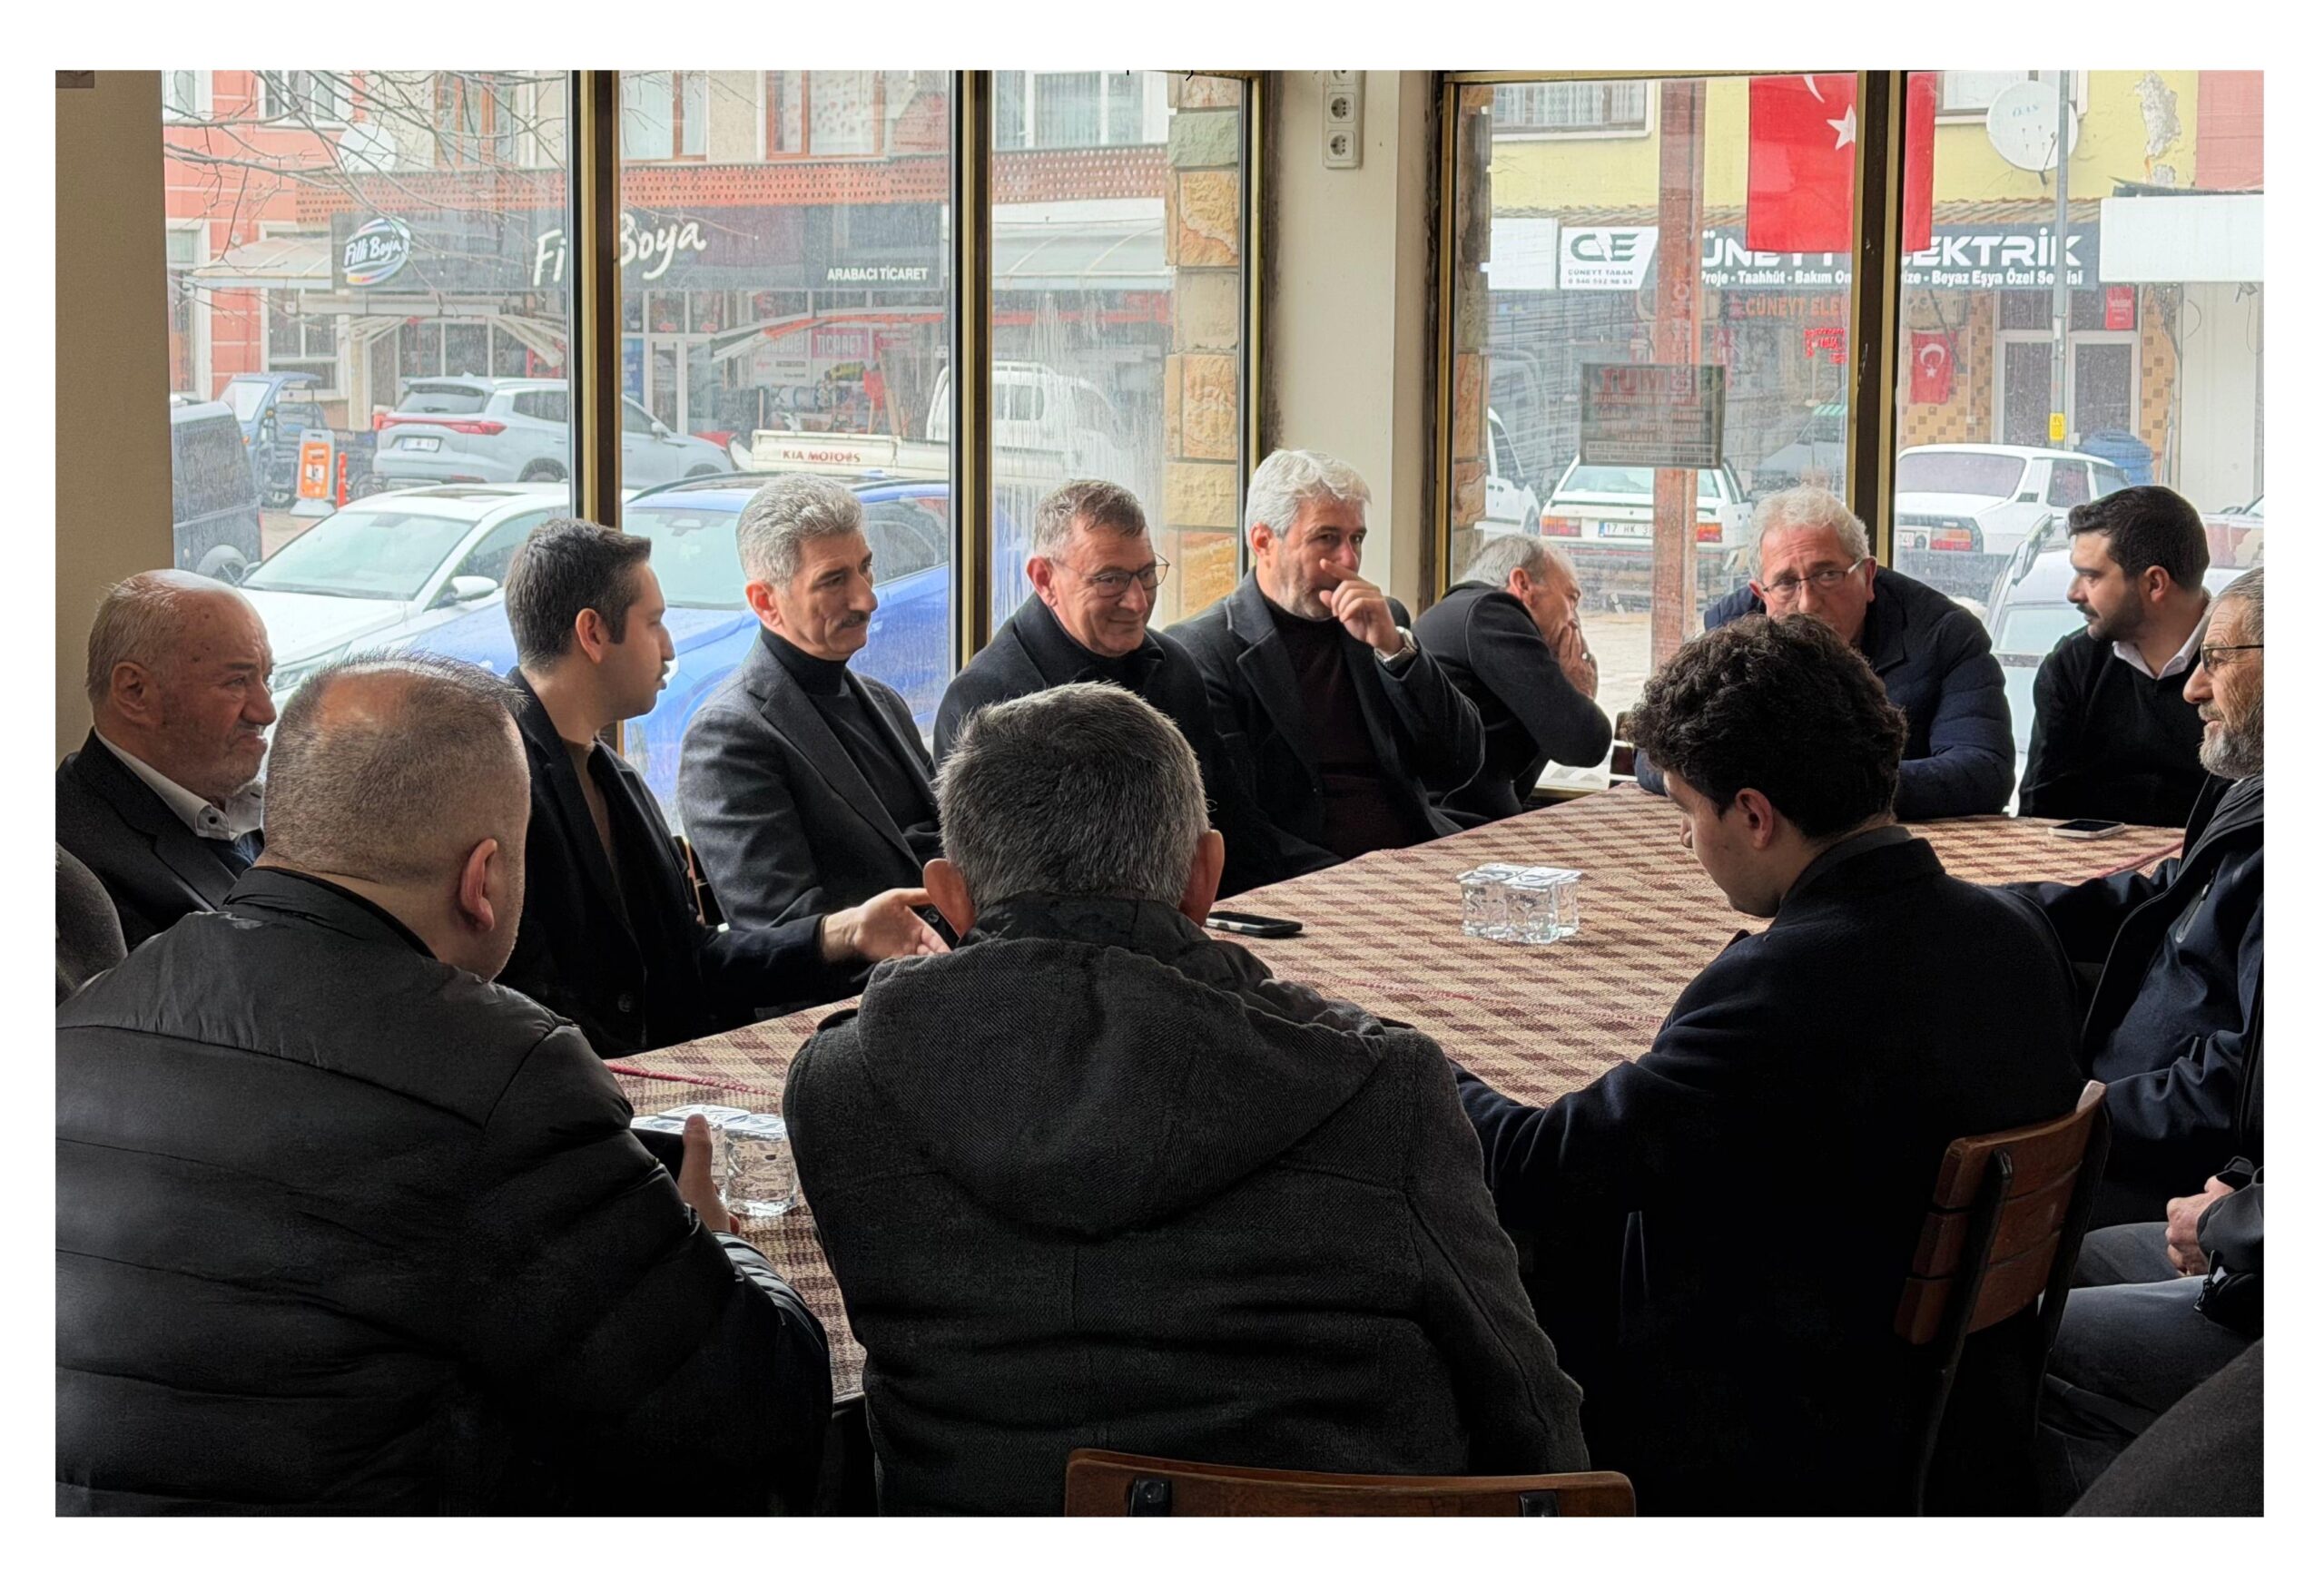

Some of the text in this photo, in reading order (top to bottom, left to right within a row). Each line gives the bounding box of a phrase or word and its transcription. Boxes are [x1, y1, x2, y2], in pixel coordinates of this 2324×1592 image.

[827, 265, 929, 281] ARABACI TİCARET
[1738, 270, 1786, 285] Taahhüt
[1794, 270, 1833, 285] Bakım
[1931, 270, 1969, 287] Beyaz
[1972, 270, 2004, 288] Eşya
[2005, 268, 2034, 285] Özel
[783, 450, 805, 460] KIA
